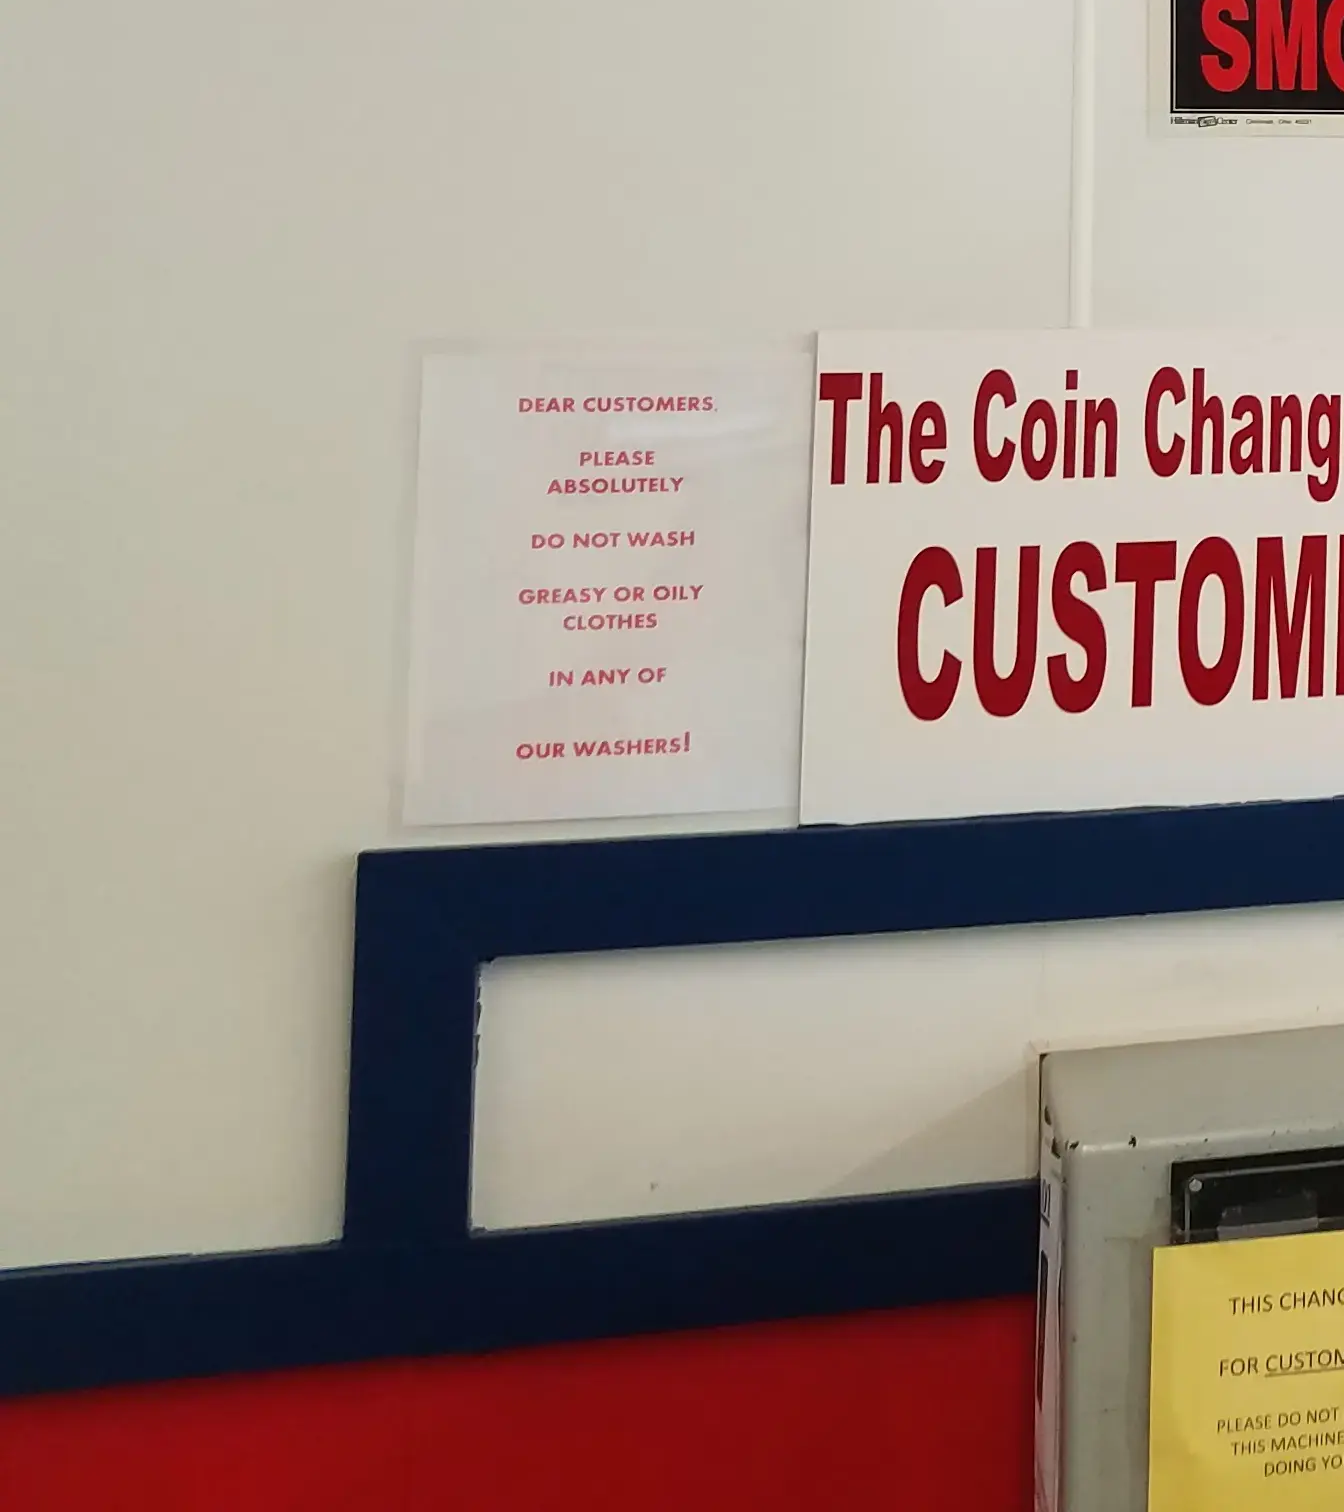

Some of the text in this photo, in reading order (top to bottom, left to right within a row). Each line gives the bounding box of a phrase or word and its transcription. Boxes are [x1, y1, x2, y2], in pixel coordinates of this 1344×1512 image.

[518, 397, 575, 413] DEAR
[819, 372, 947, 485] The
[972, 368, 1118, 483] Coin
[579, 451, 655, 467] PLEASE
[547, 477, 684, 495] ABSOLUTELY
[531, 531, 695, 549] DO NOT WASH
[518, 585, 704, 605] GREASY OR OILY
[563, 614, 657, 631] CLOTHES
[548, 667, 667, 687] IN ANY OF
[515, 732, 691, 759] OUR WASHERS!
[1228, 1294, 1273, 1316] THIS
[1219, 1356, 1259, 1376] FOR
[1216, 1414, 1272, 1434] PLEASE
[1278, 1411, 1301, 1428] DO
[1306, 1406, 1339, 1424] NOT
[1230, 1438, 1266, 1456] THIS
[1270, 1430, 1344, 1453] MACHINE
[1264, 1456, 1317, 1478] DOING
